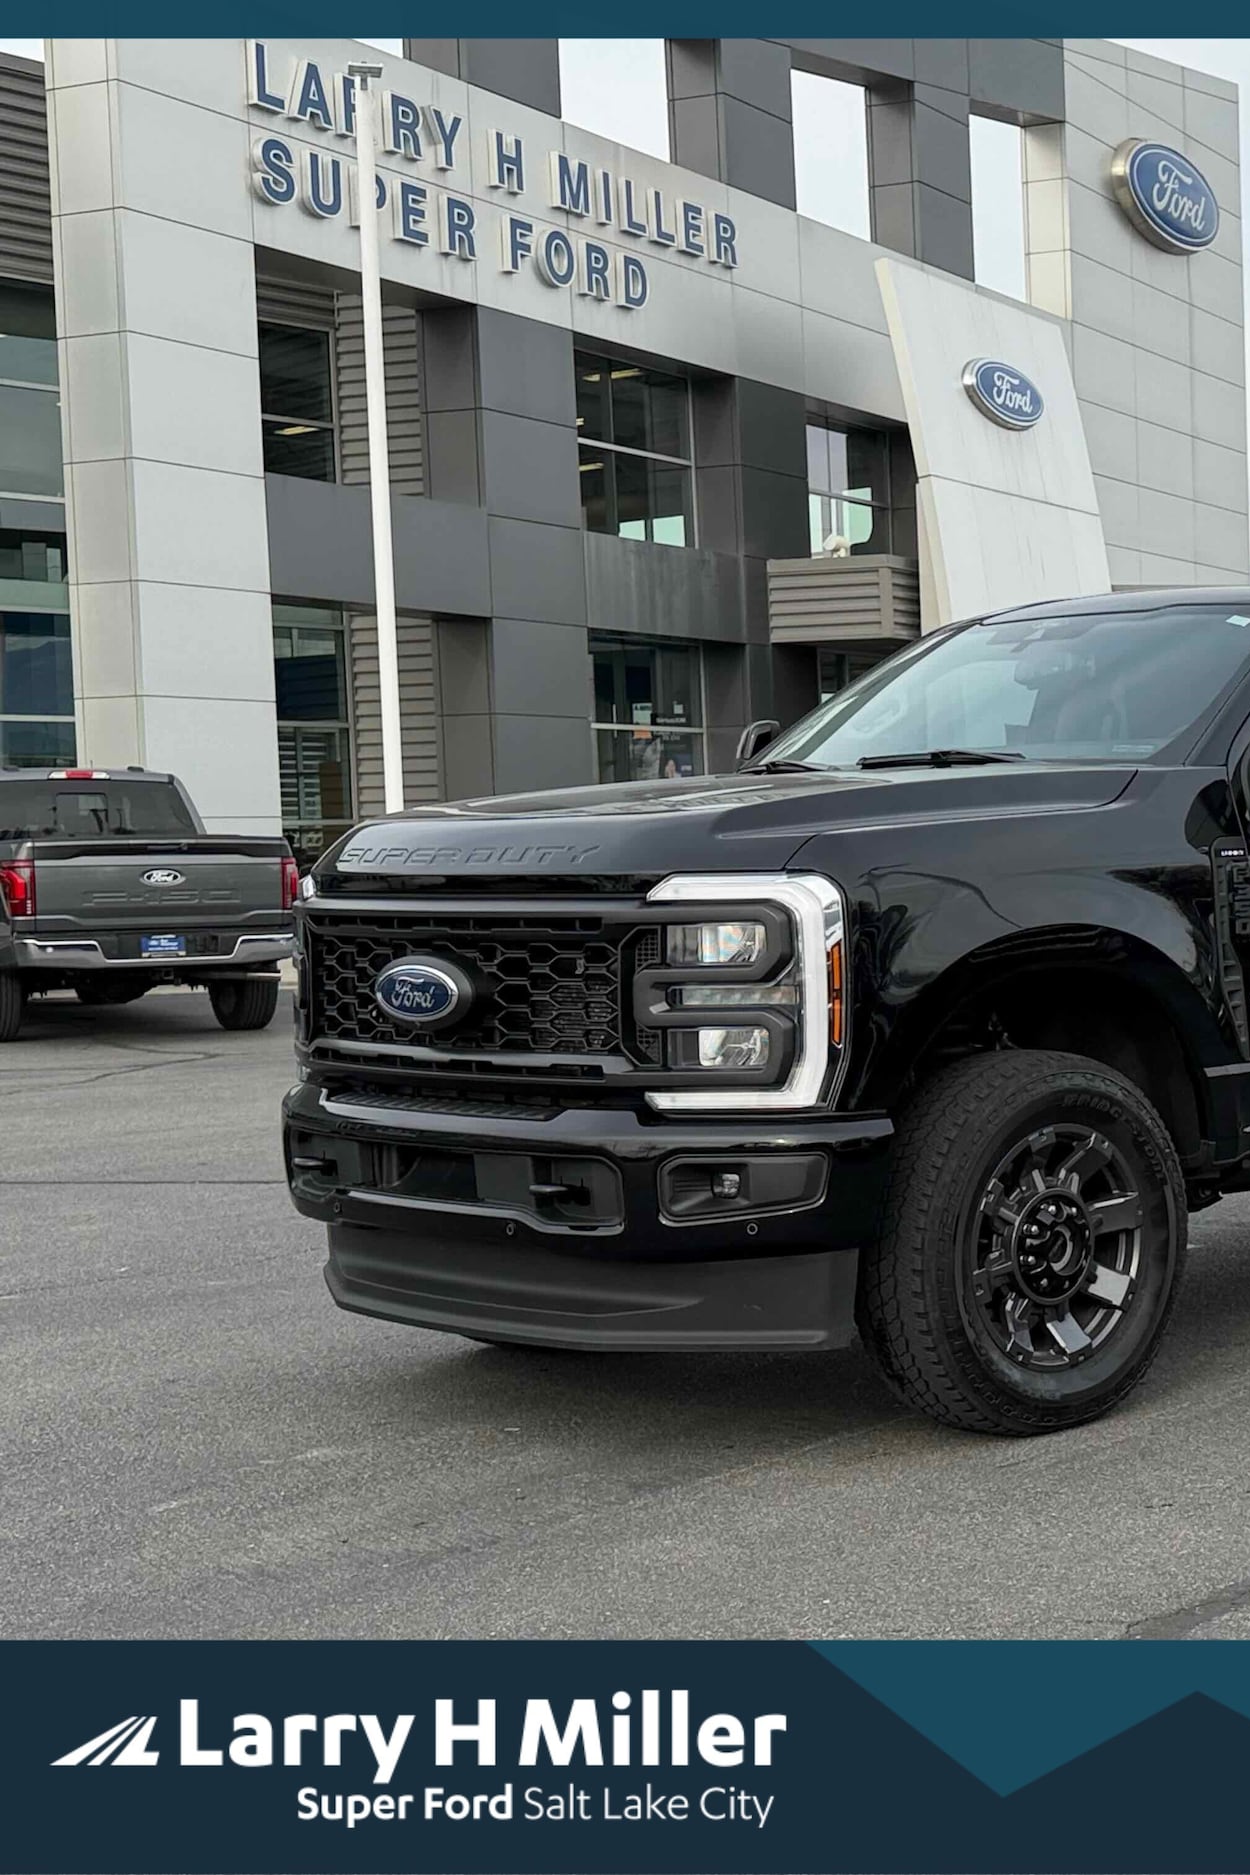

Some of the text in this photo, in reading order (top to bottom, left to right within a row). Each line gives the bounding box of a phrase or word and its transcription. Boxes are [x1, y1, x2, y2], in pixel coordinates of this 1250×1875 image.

[490, 129, 525, 194] H
[551, 150, 739, 270] MILLER
[1151, 159, 1206, 231] Ford
[503, 213, 649, 310] FORD
[992, 370, 1034, 414] Ford
[150, 872, 175, 882] Ford
[337, 844, 601, 866] SUPER DUTY
[391, 976, 435, 1008] Ford
